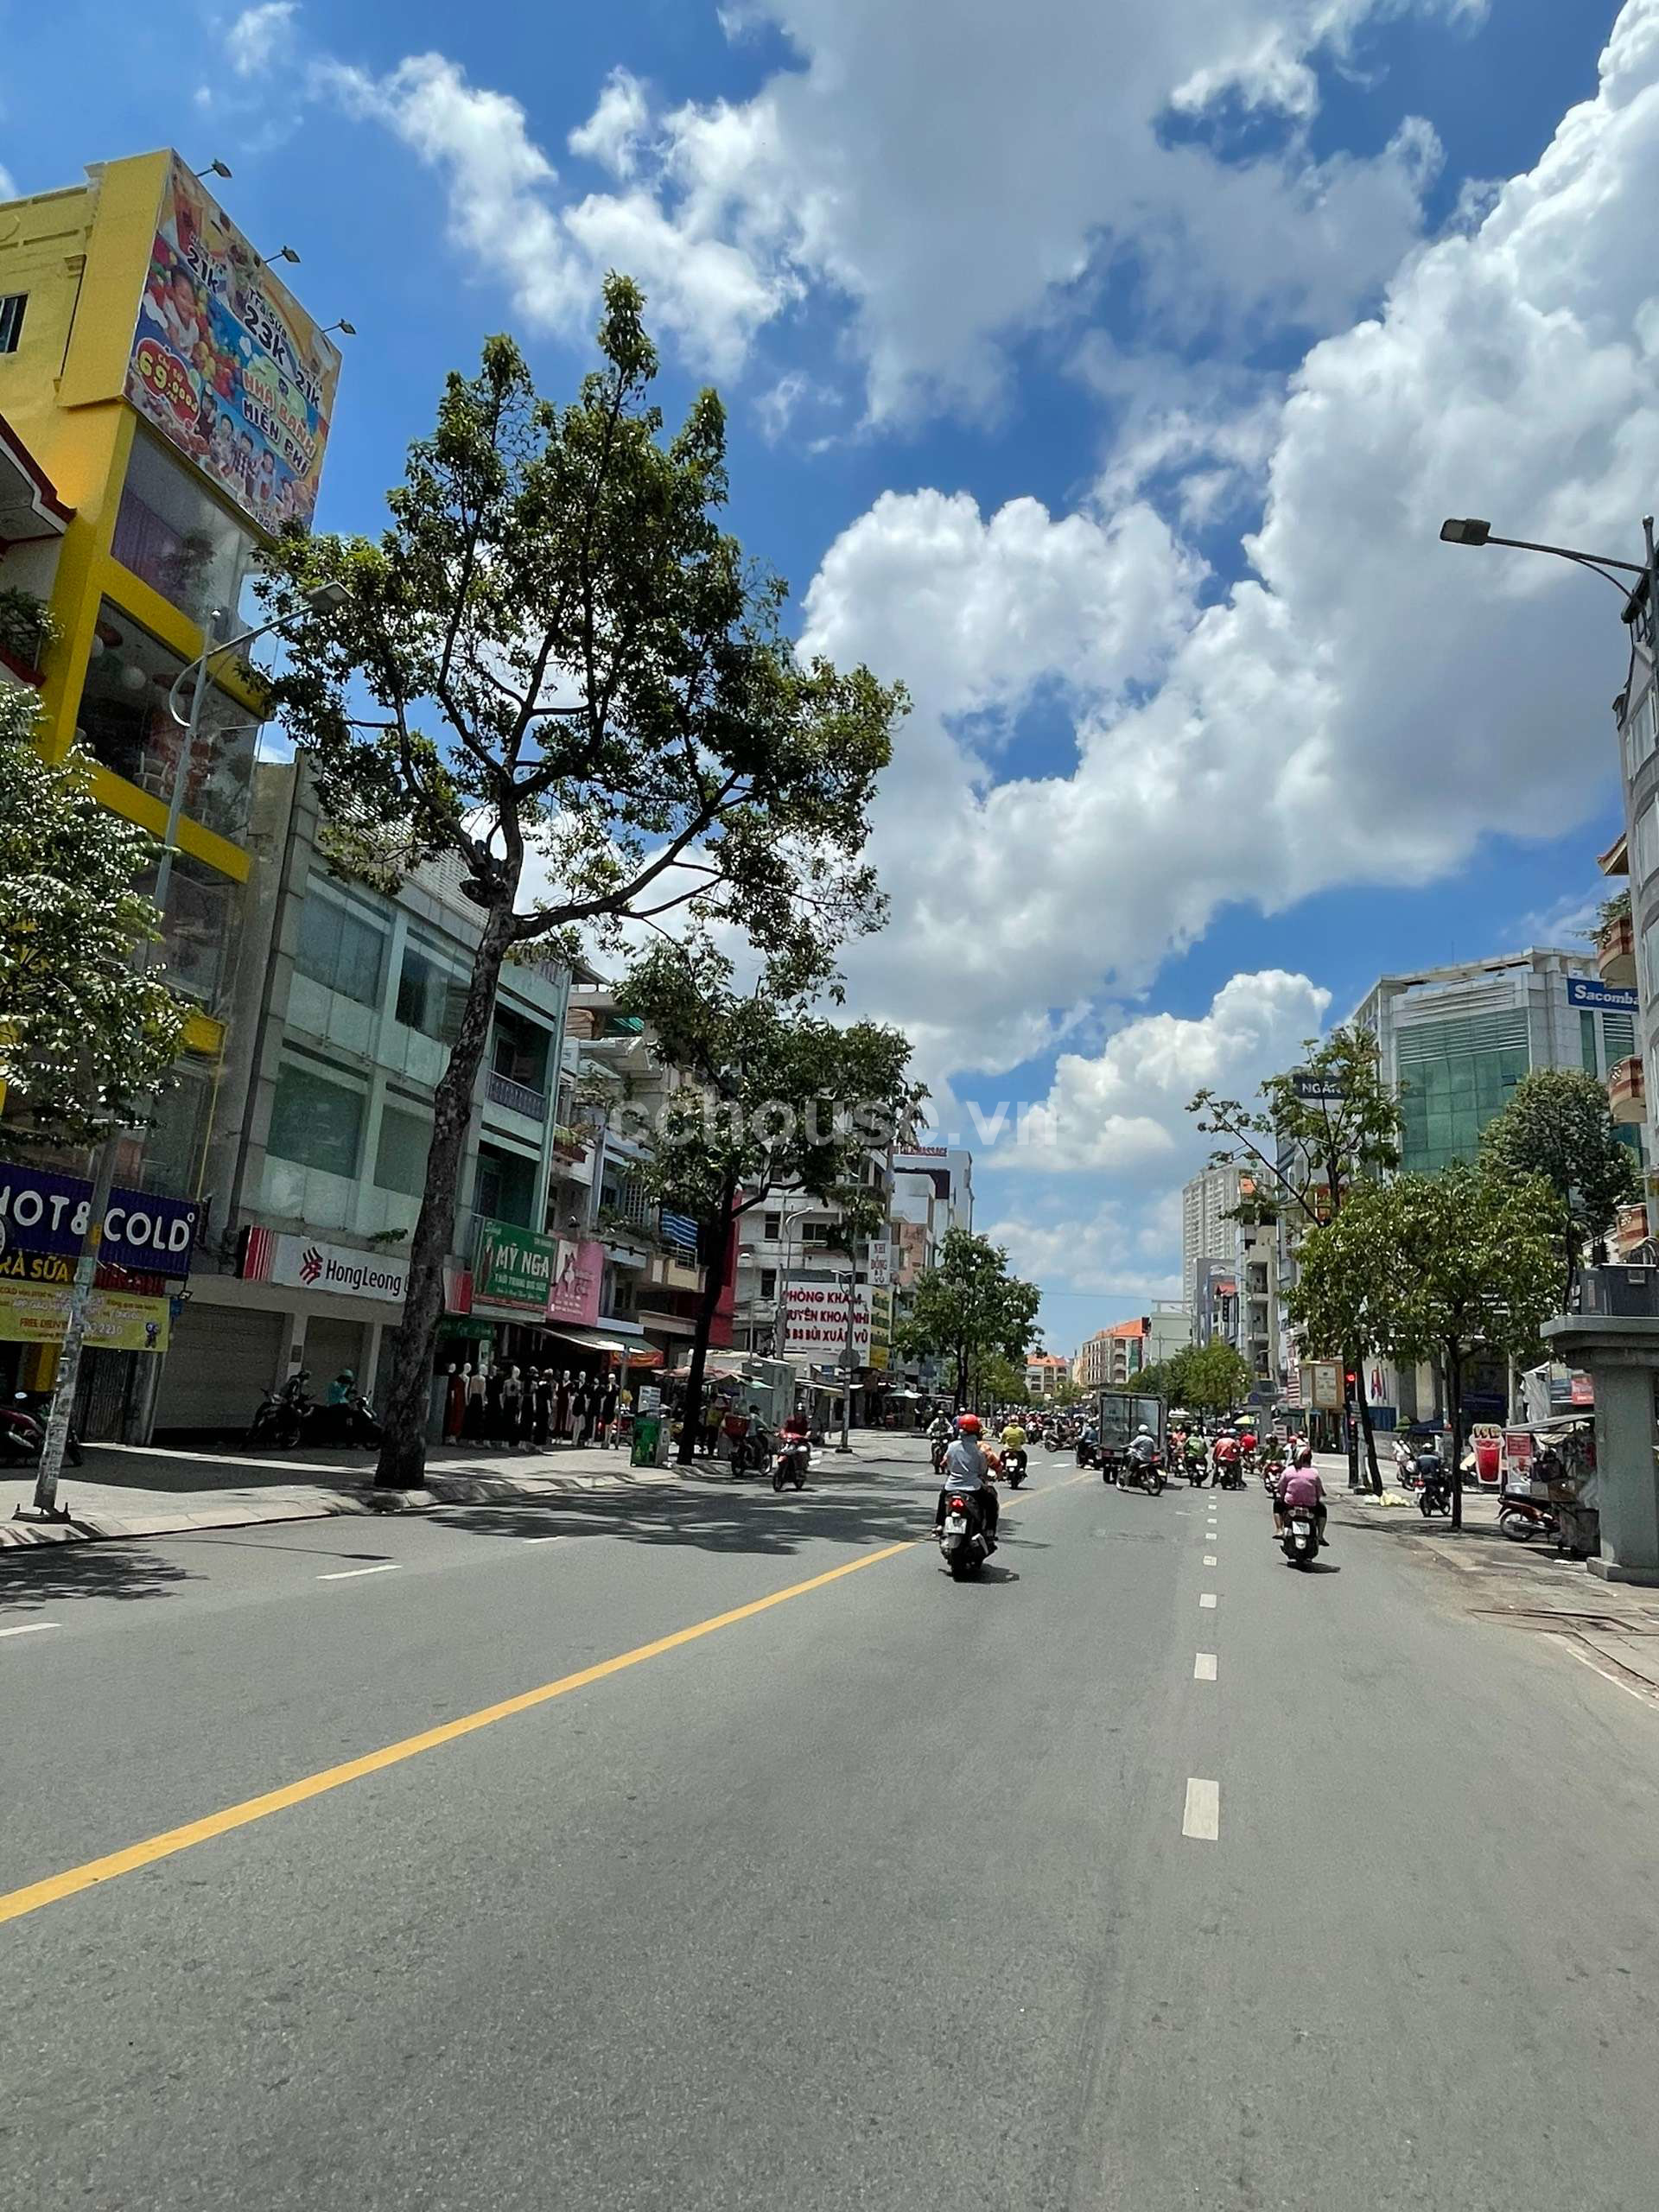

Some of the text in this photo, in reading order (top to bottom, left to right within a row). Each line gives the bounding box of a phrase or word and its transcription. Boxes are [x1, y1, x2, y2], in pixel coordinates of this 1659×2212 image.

[30, 1255, 68, 1281] SỮA
[521, 1250, 550, 1278] NGA
[326, 1259, 402, 1296] HongLeong
[820, 1311, 849, 1323] KHOA
[853, 1313, 869, 1325] NHI
[822, 1328, 849, 1342] XUÂ
